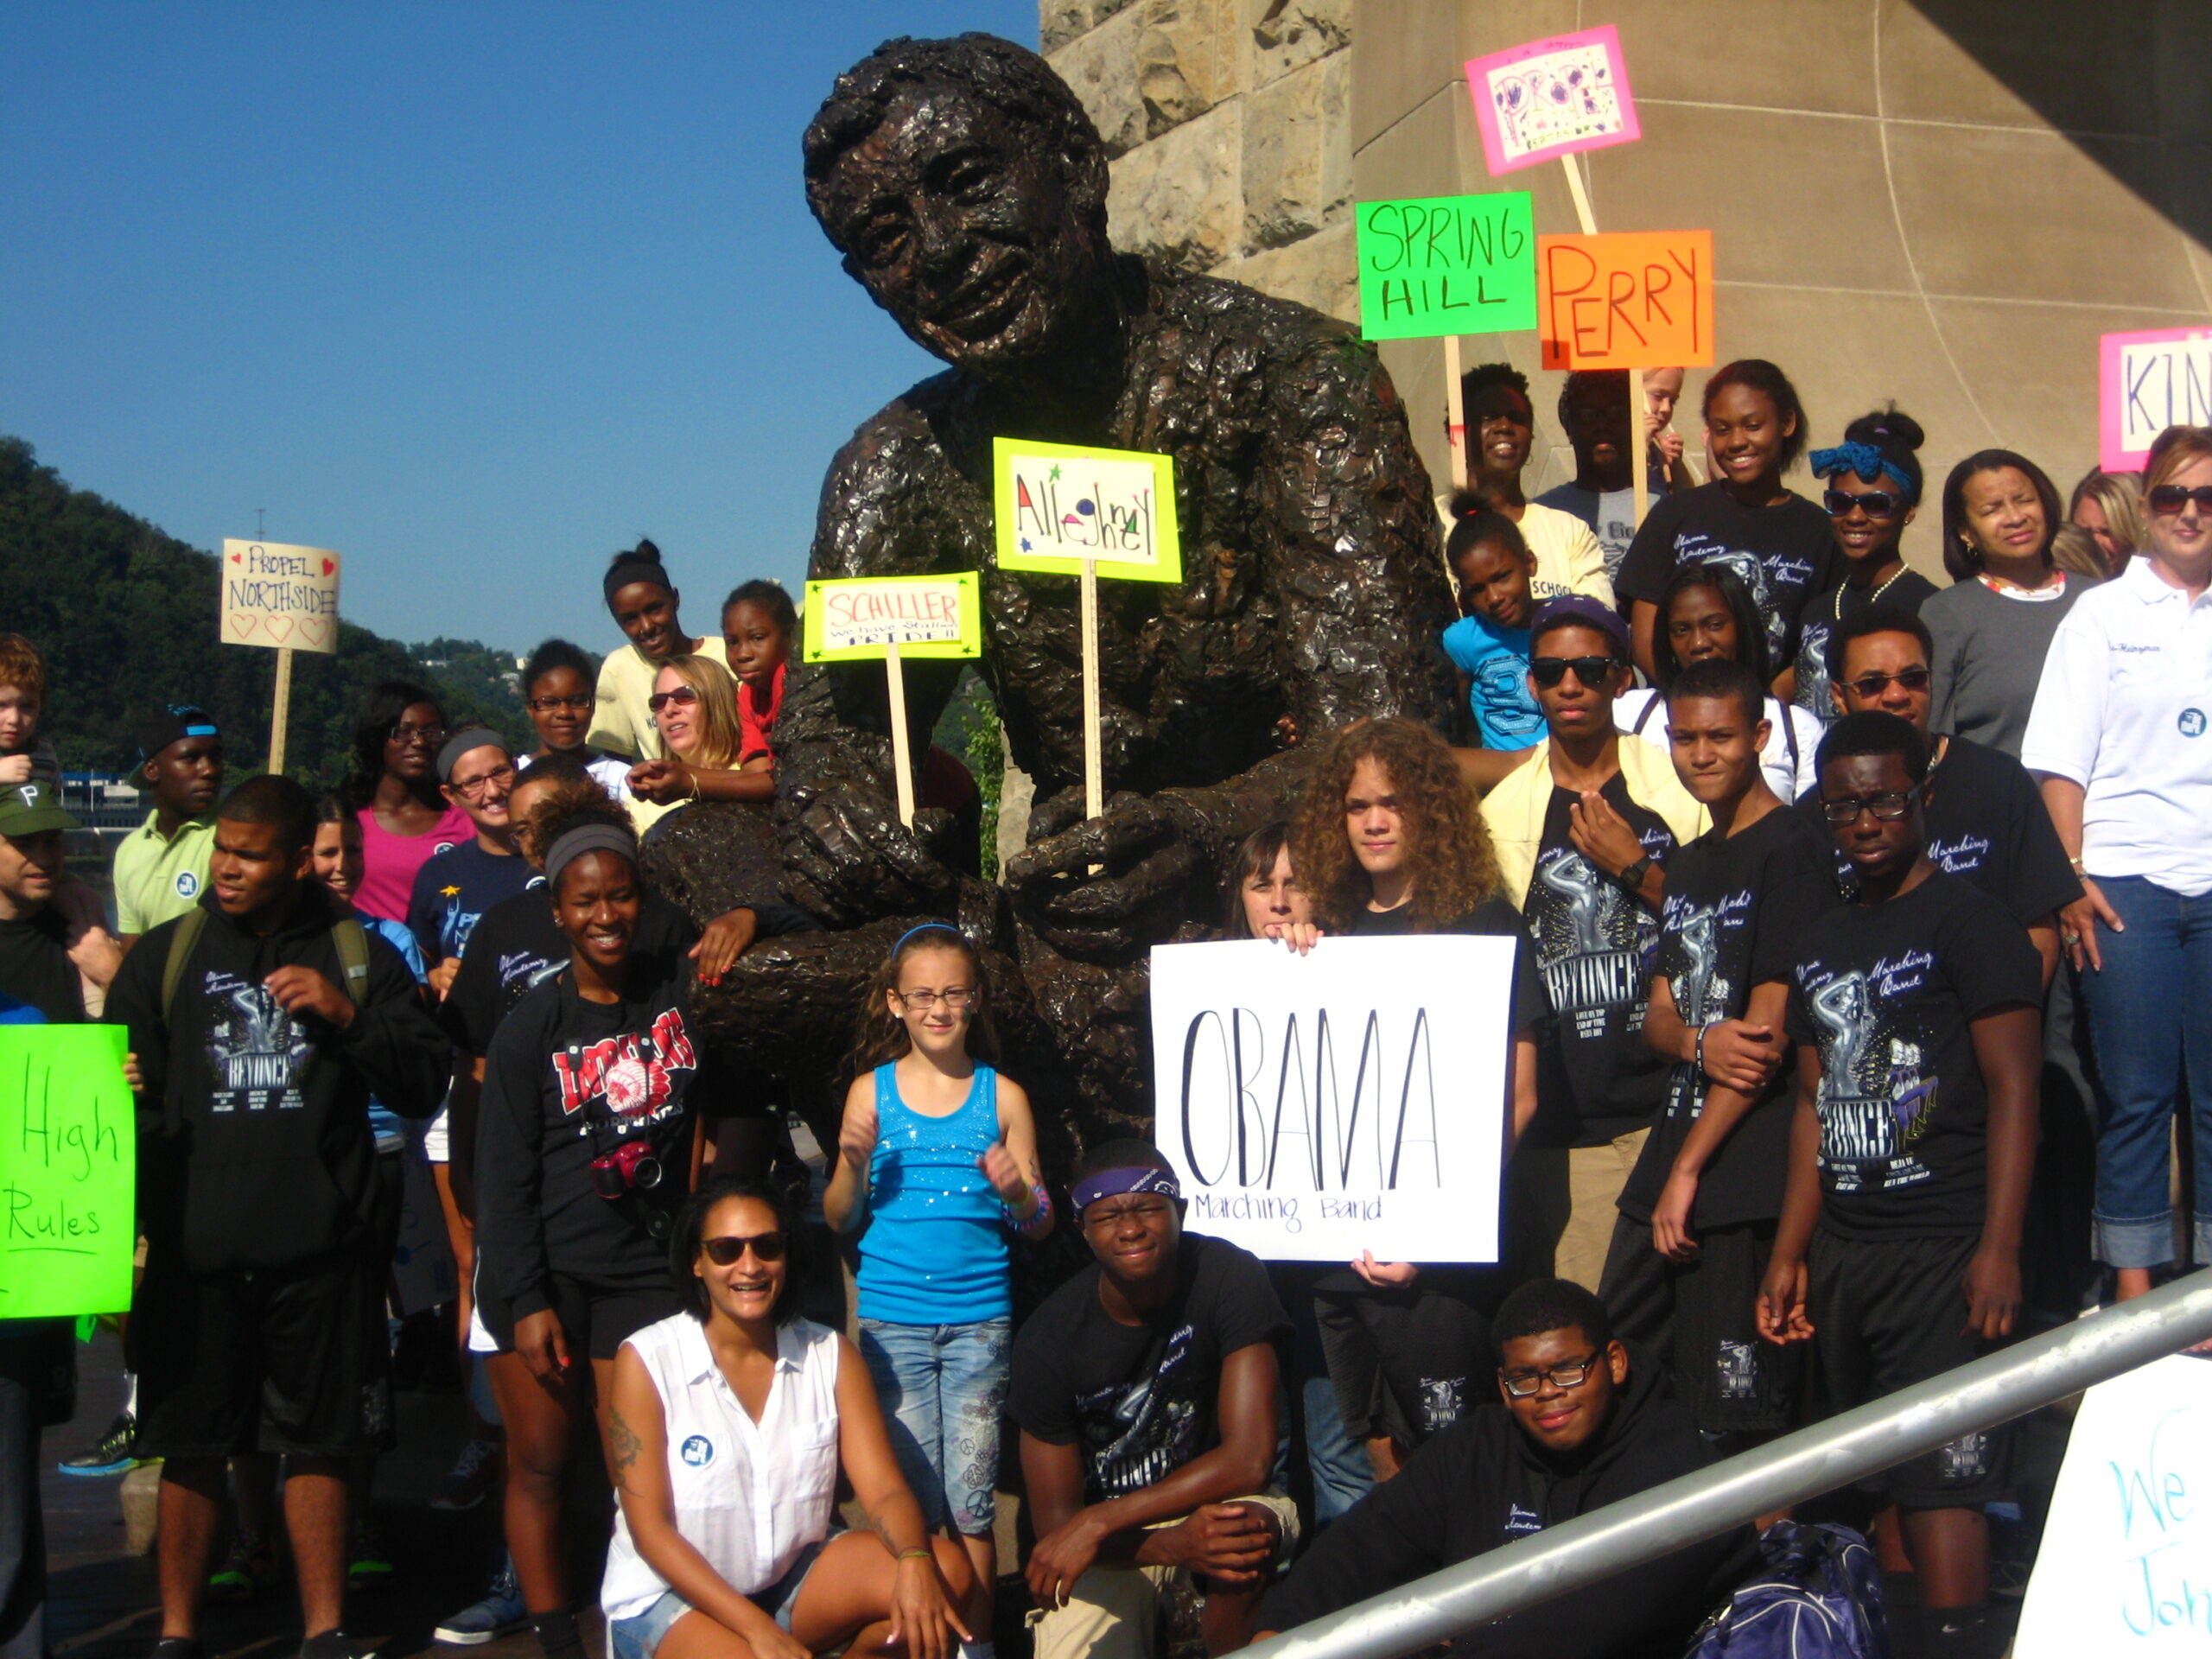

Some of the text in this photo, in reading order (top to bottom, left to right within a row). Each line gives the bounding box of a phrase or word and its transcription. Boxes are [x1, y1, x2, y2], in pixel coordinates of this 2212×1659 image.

[1368, 204, 1524, 271] SPRING
[1382, 275, 1508, 321] HILL
[1548, 245, 1699, 359] PERRY
[249, 544, 315, 577] PROPEL
[229, 578, 336, 614] NORTHSIDE
[828, 591, 957, 628] SCHILLER
[1867, 950, 1932, 982] Marching
[1878, 974, 1923, 996] Band
[23, 1052, 118, 1182] High
[1180, 1007, 1441, 1192] OBAMA
[3, 1180, 100, 1239] Rules
[1194, 1193, 1382, 1234] Marching Band
[2107, 1408, 2195, 1543] We
